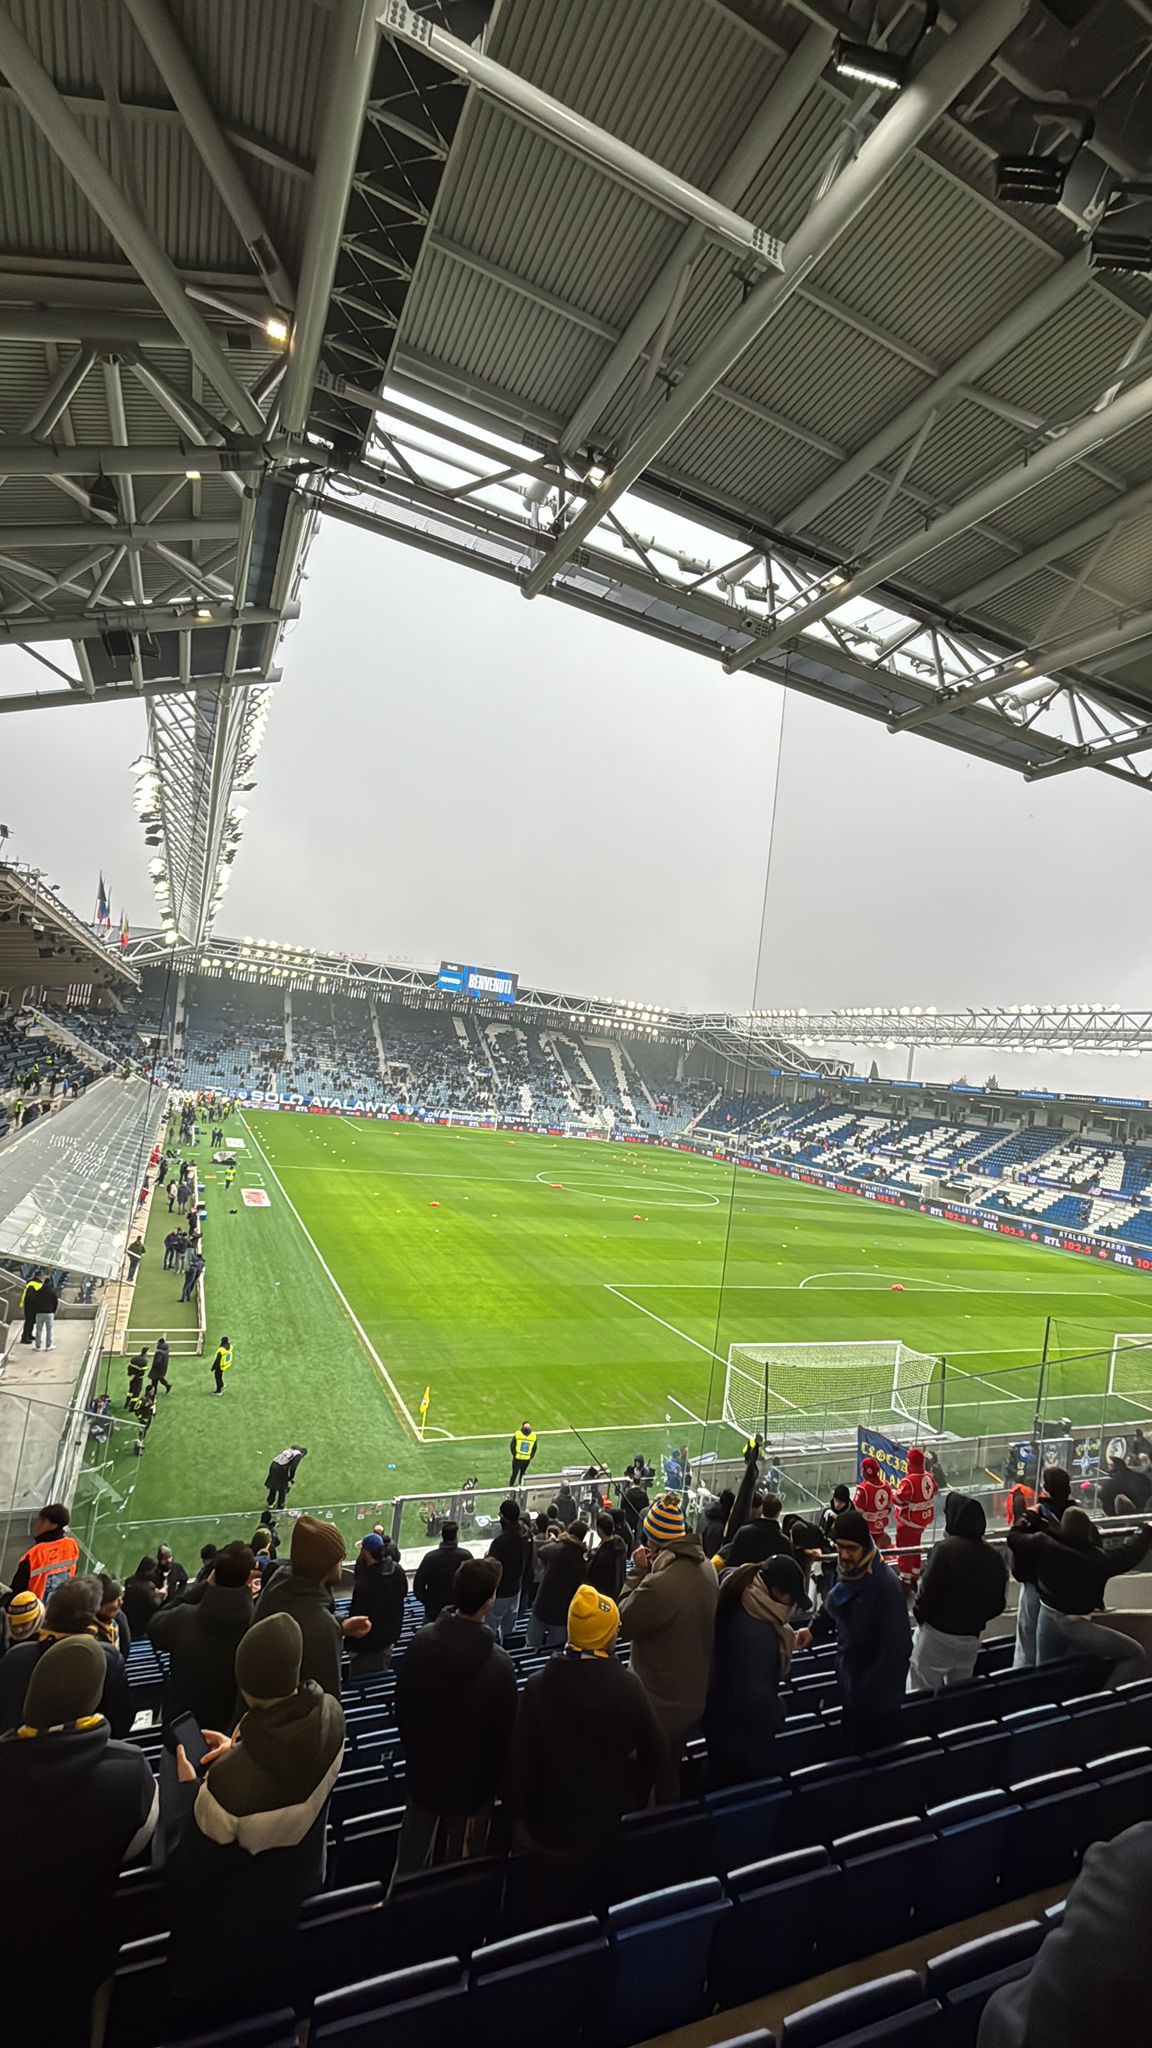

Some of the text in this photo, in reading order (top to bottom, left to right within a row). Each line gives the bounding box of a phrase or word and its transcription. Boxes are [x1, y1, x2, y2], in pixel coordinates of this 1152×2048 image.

[468, 973, 512, 995] BENVENUTI
[251, 1091, 400, 1115] SOLO ATALANTA
[865, 1190, 876, 1200] RTL
[930, 1207, 967, 1223] RTL 102.5
[983, 1220, 1025, 1238] RTL 102.5
[1044, 1235, 1091, 1255] RTL 102.5
[1114, 1253, 1133, 1266] RTL
